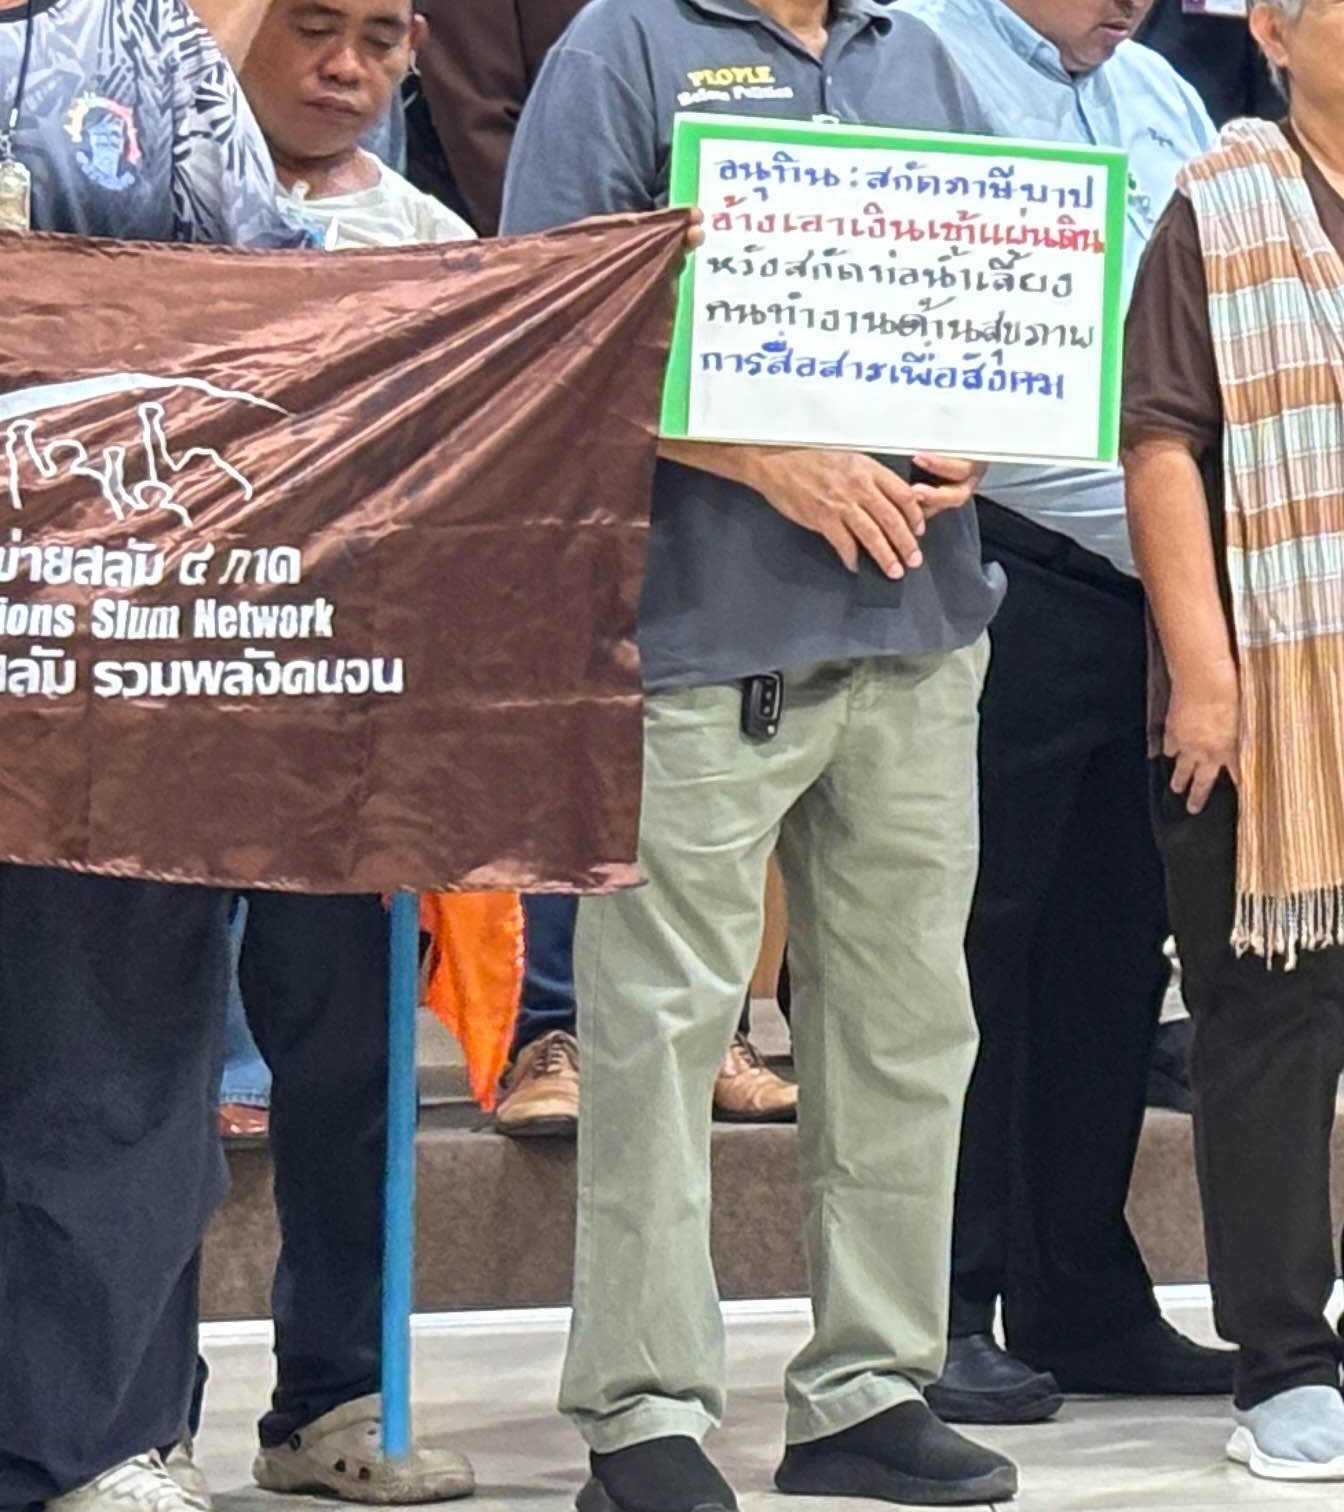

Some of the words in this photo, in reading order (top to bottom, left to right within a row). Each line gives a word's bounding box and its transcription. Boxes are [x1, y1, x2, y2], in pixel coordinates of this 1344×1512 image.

[218, 546, 301, 586] ภาค
[91, 597, 182, 640] Slum
[193, 596, 335, 640] Network
[93, 646, 405, 697] รวมพลังคนจน
